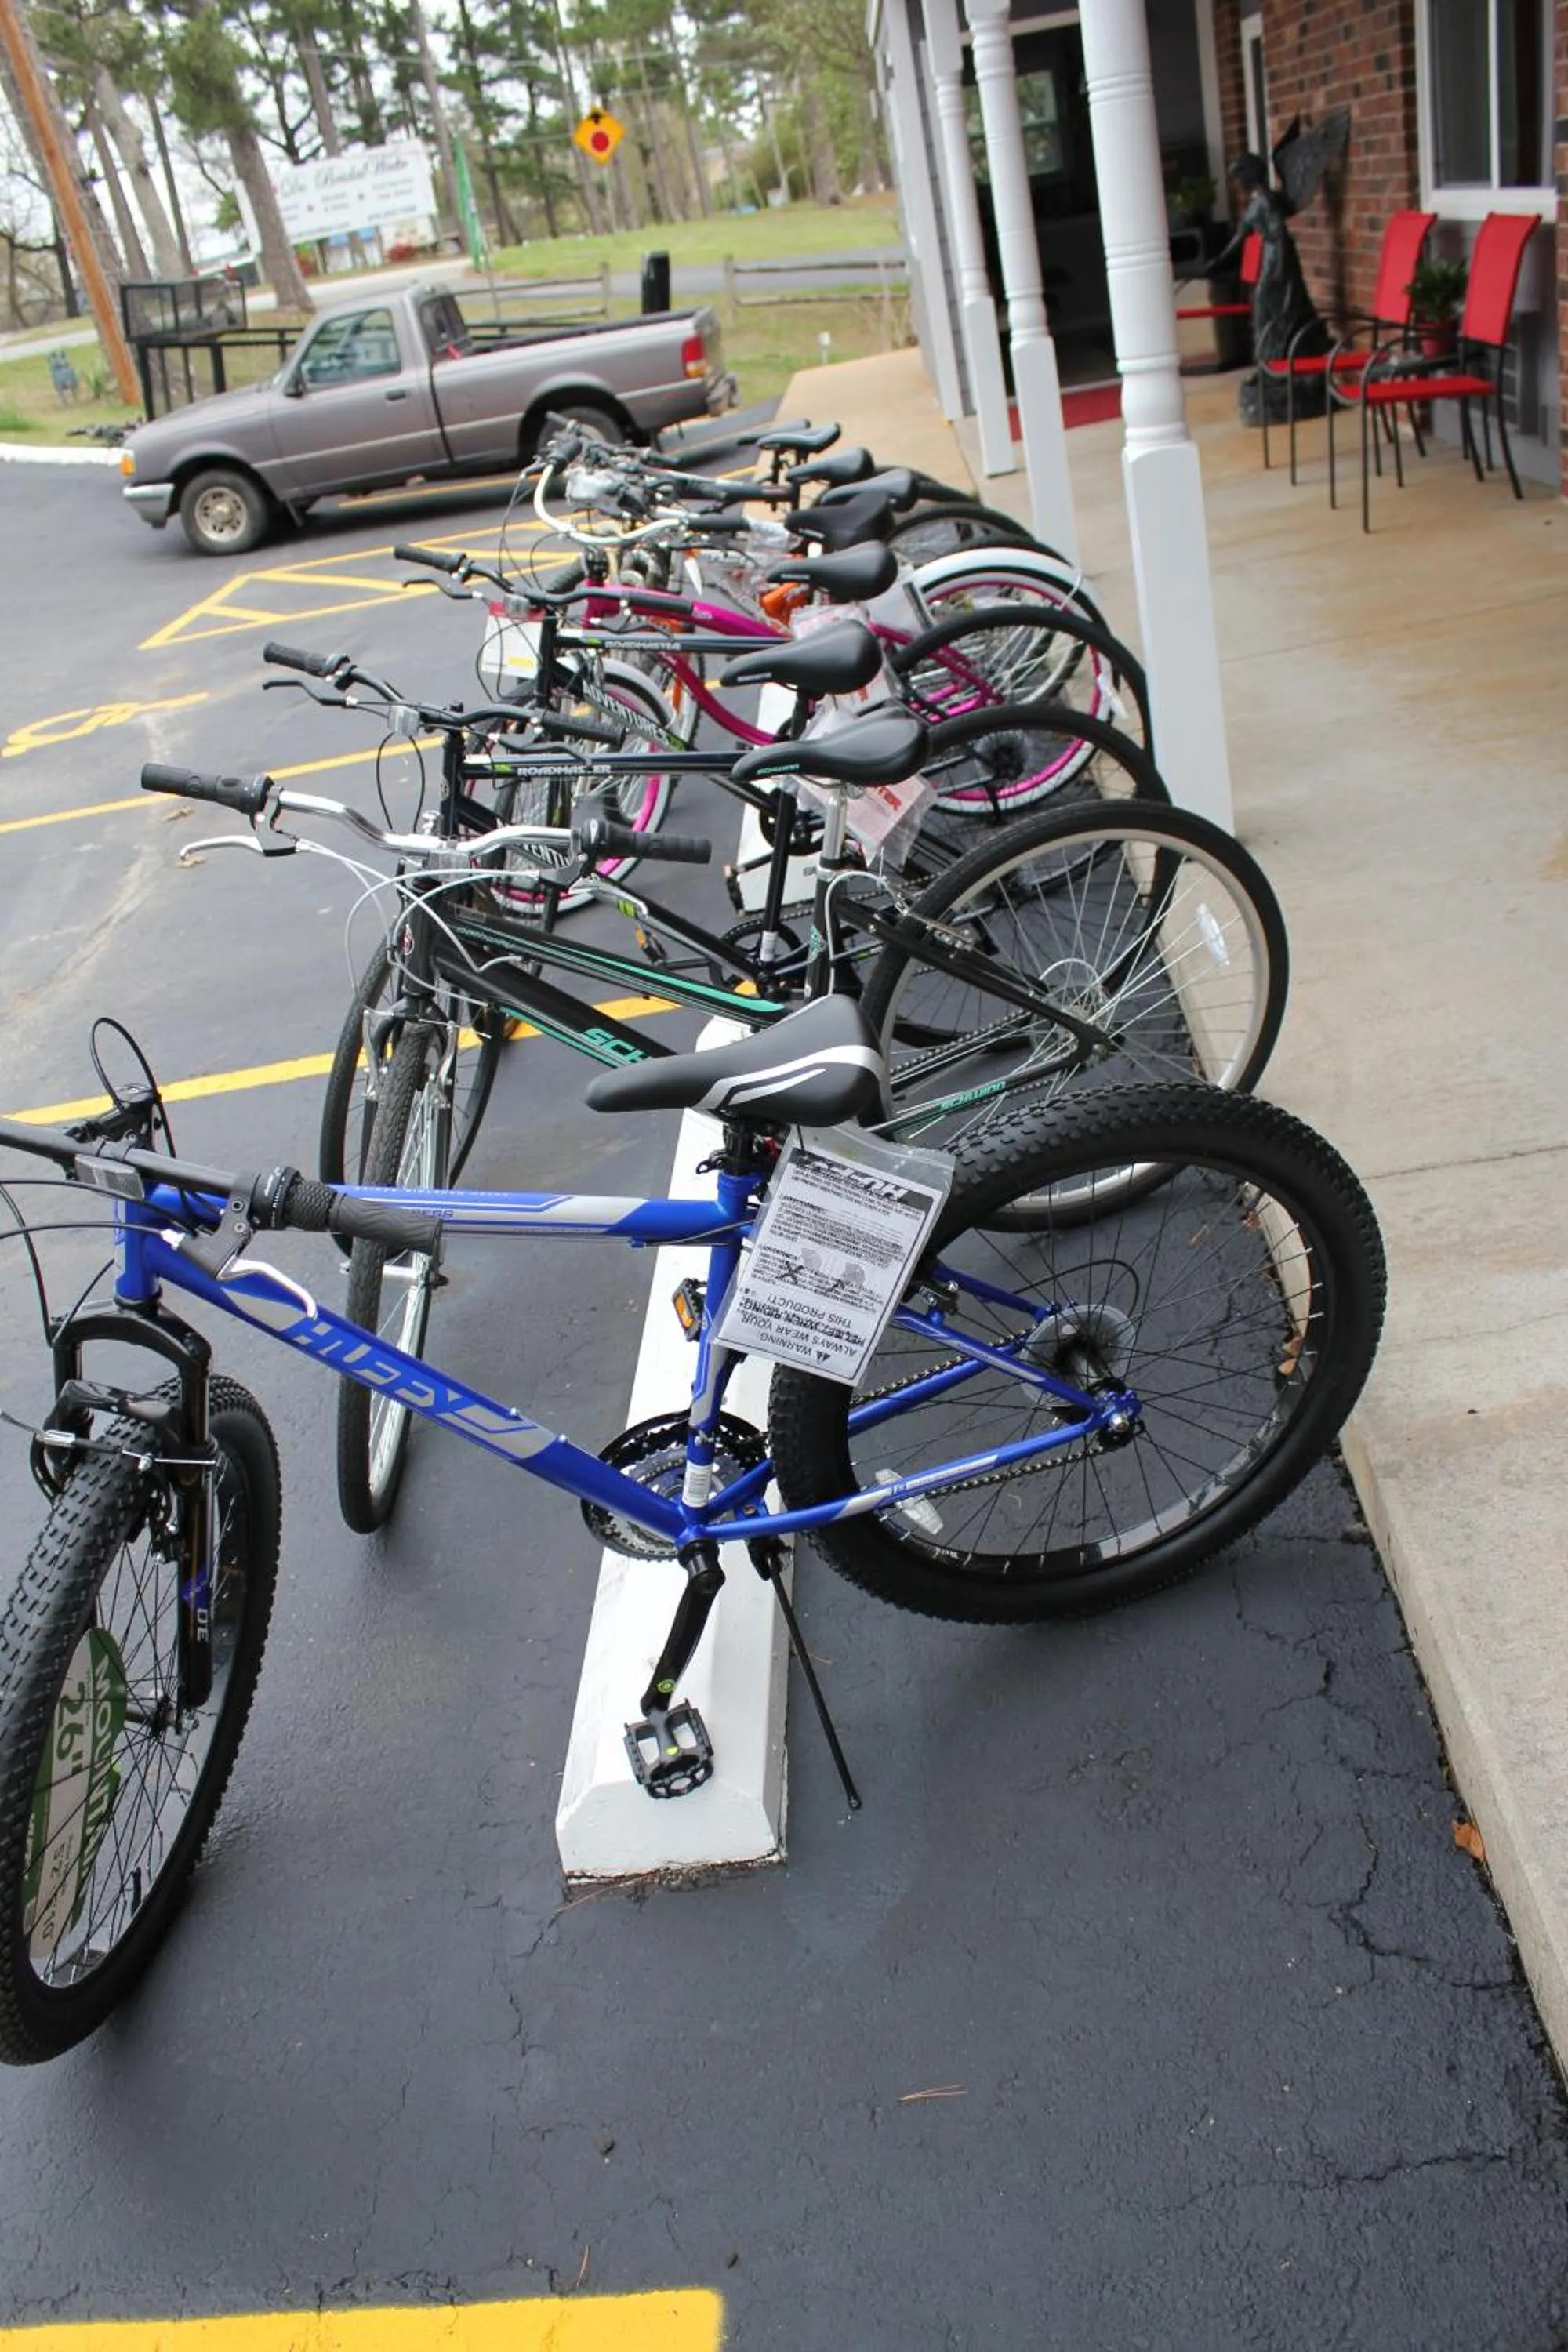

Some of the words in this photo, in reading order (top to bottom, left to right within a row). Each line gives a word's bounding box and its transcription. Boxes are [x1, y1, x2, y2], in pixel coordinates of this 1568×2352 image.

[827, 1313, 852, 1328] THIS
[775, 1323, 811, 1342] WEAR
[812, 1333, 857, 1356] ALWAYS
[292, 1322, 466, 1409] HUFFY
